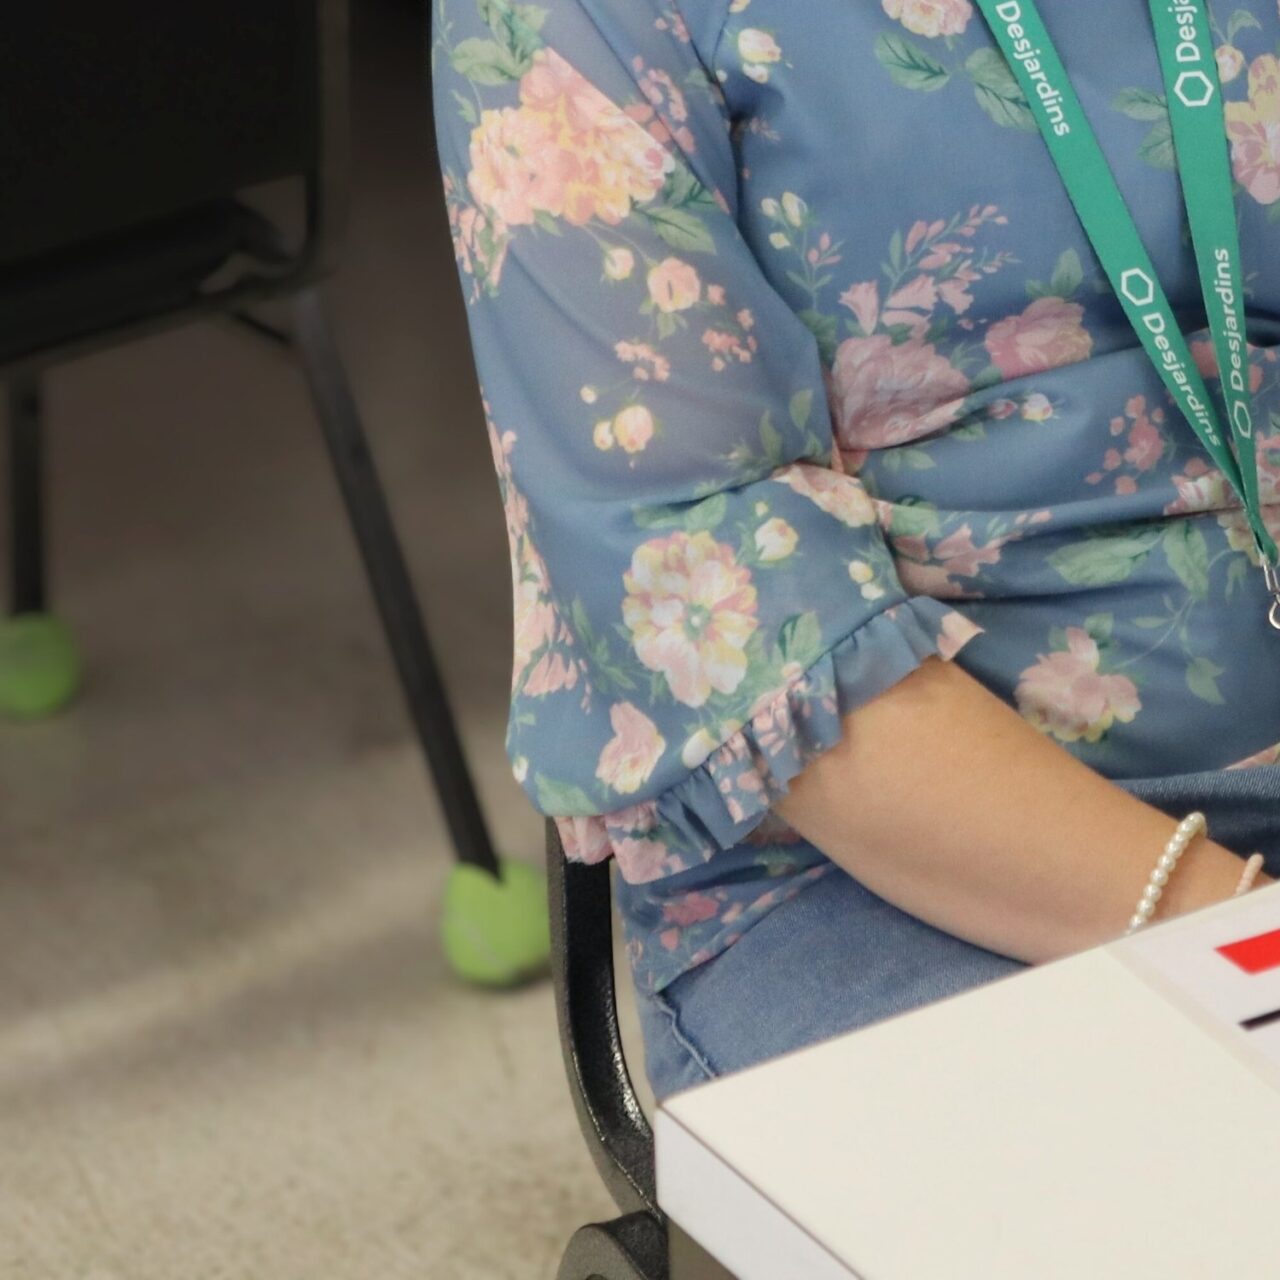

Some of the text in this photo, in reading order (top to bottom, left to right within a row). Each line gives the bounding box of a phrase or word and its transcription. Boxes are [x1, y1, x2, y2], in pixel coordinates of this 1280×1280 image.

[995, 0, 1070, 137] Desjardins
[1142, 311, 1221, 448] Desjardins
[1213, 247, 1245, 393] Desjardins
